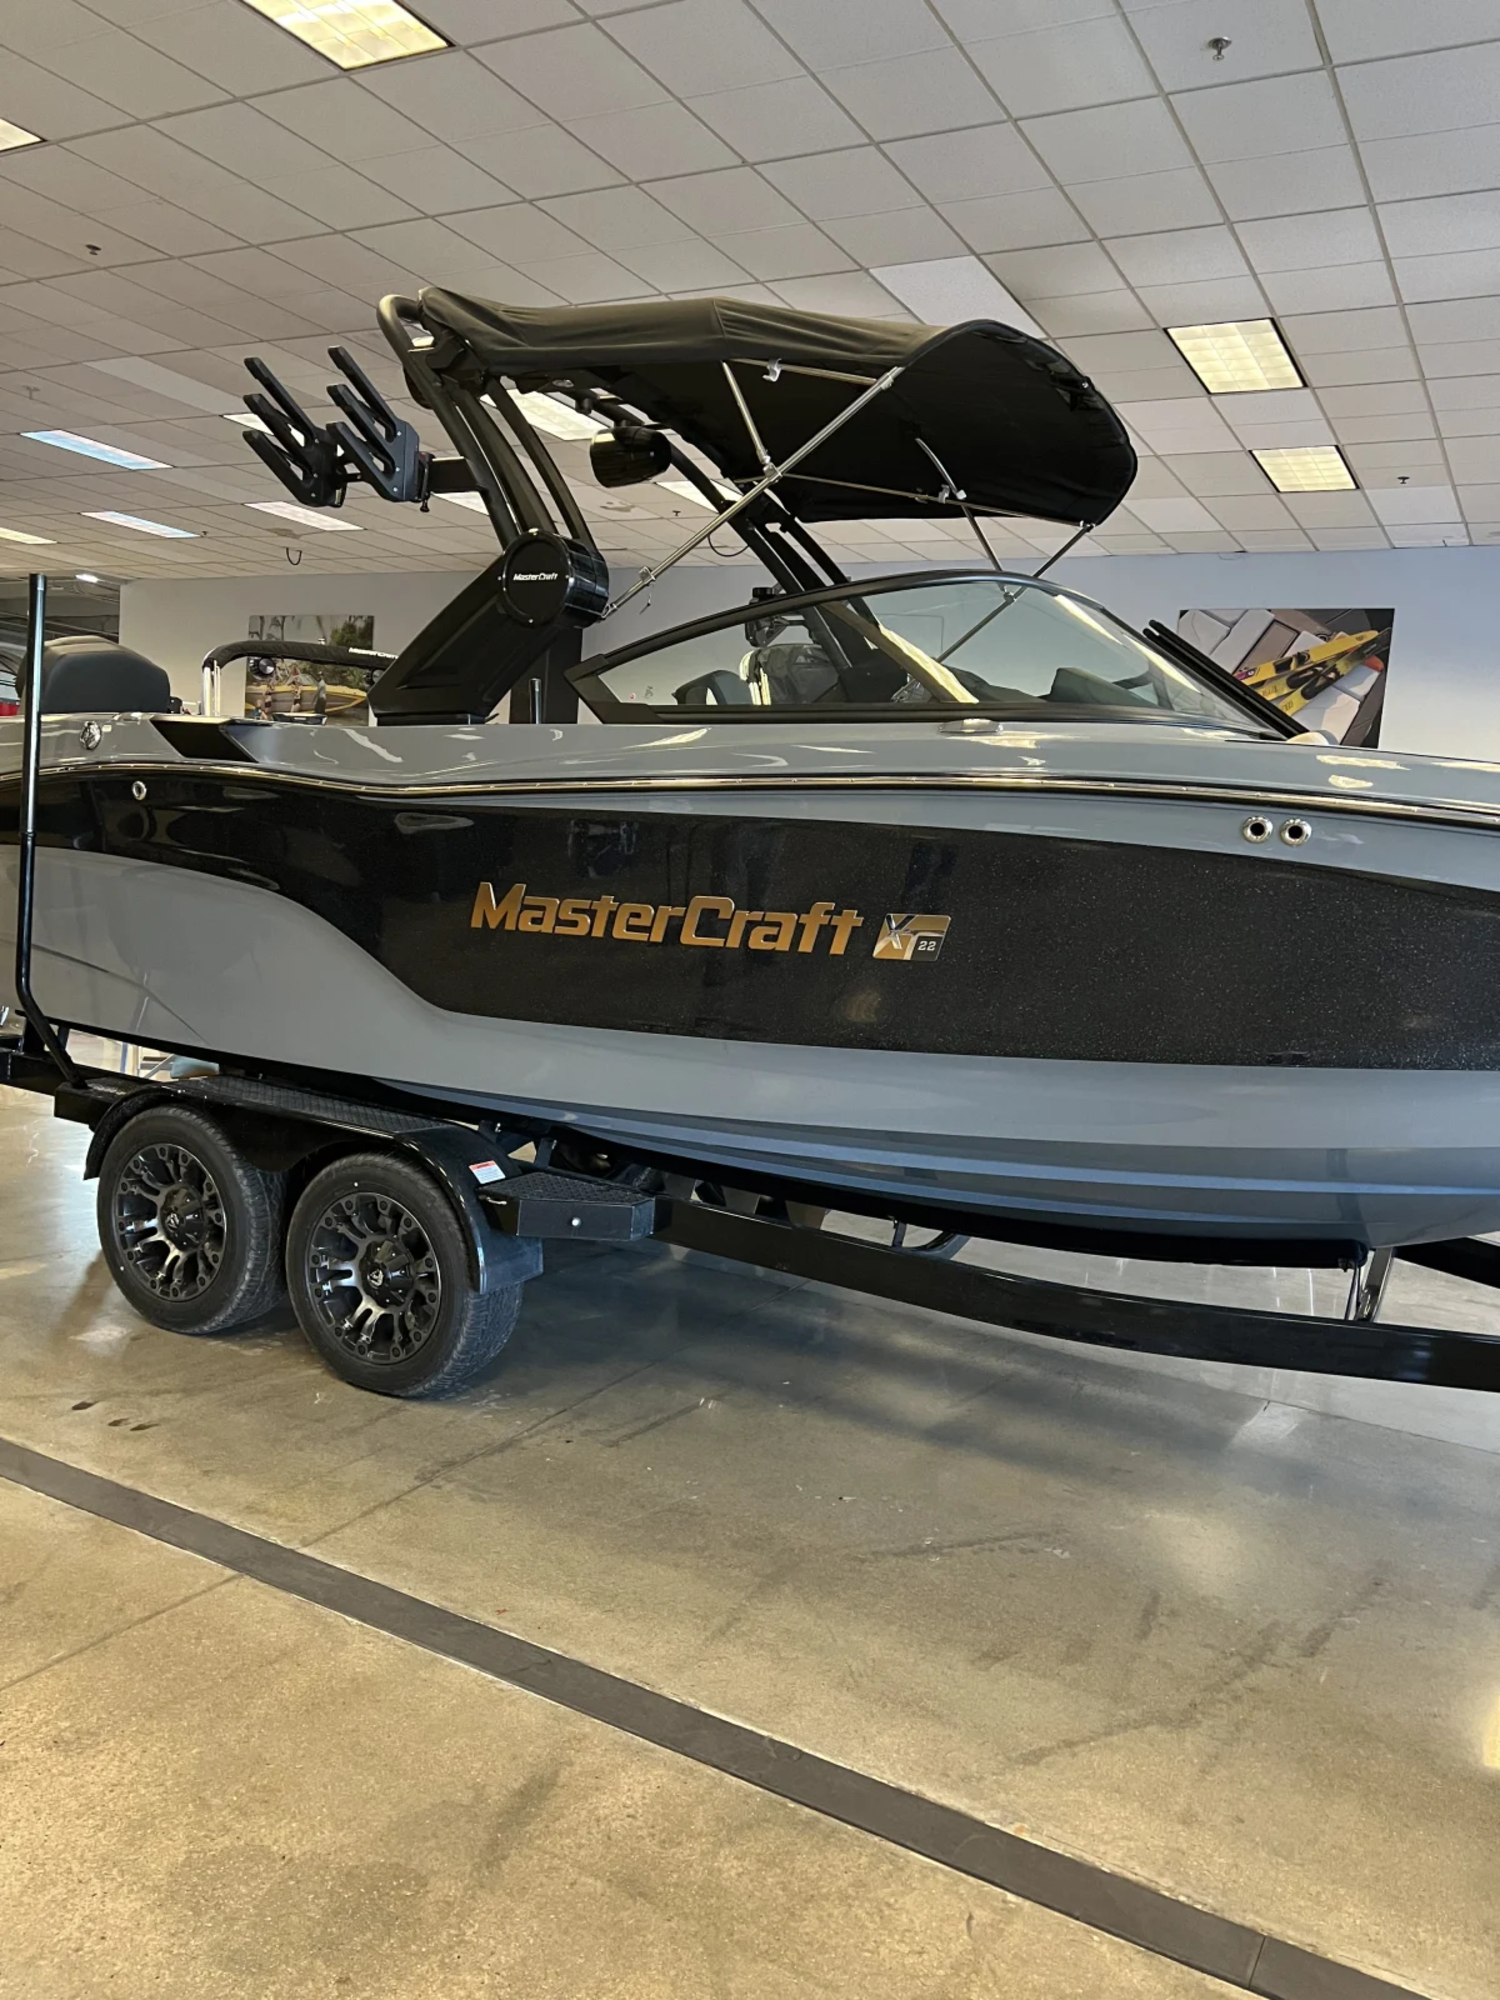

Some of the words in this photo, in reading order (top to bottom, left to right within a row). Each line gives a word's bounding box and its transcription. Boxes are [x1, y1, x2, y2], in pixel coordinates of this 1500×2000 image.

[513, 572, 558, 581] MasterCraft
[470, 881, 864, 955] MasterCraft
[917, 940, 936, 951] 22
